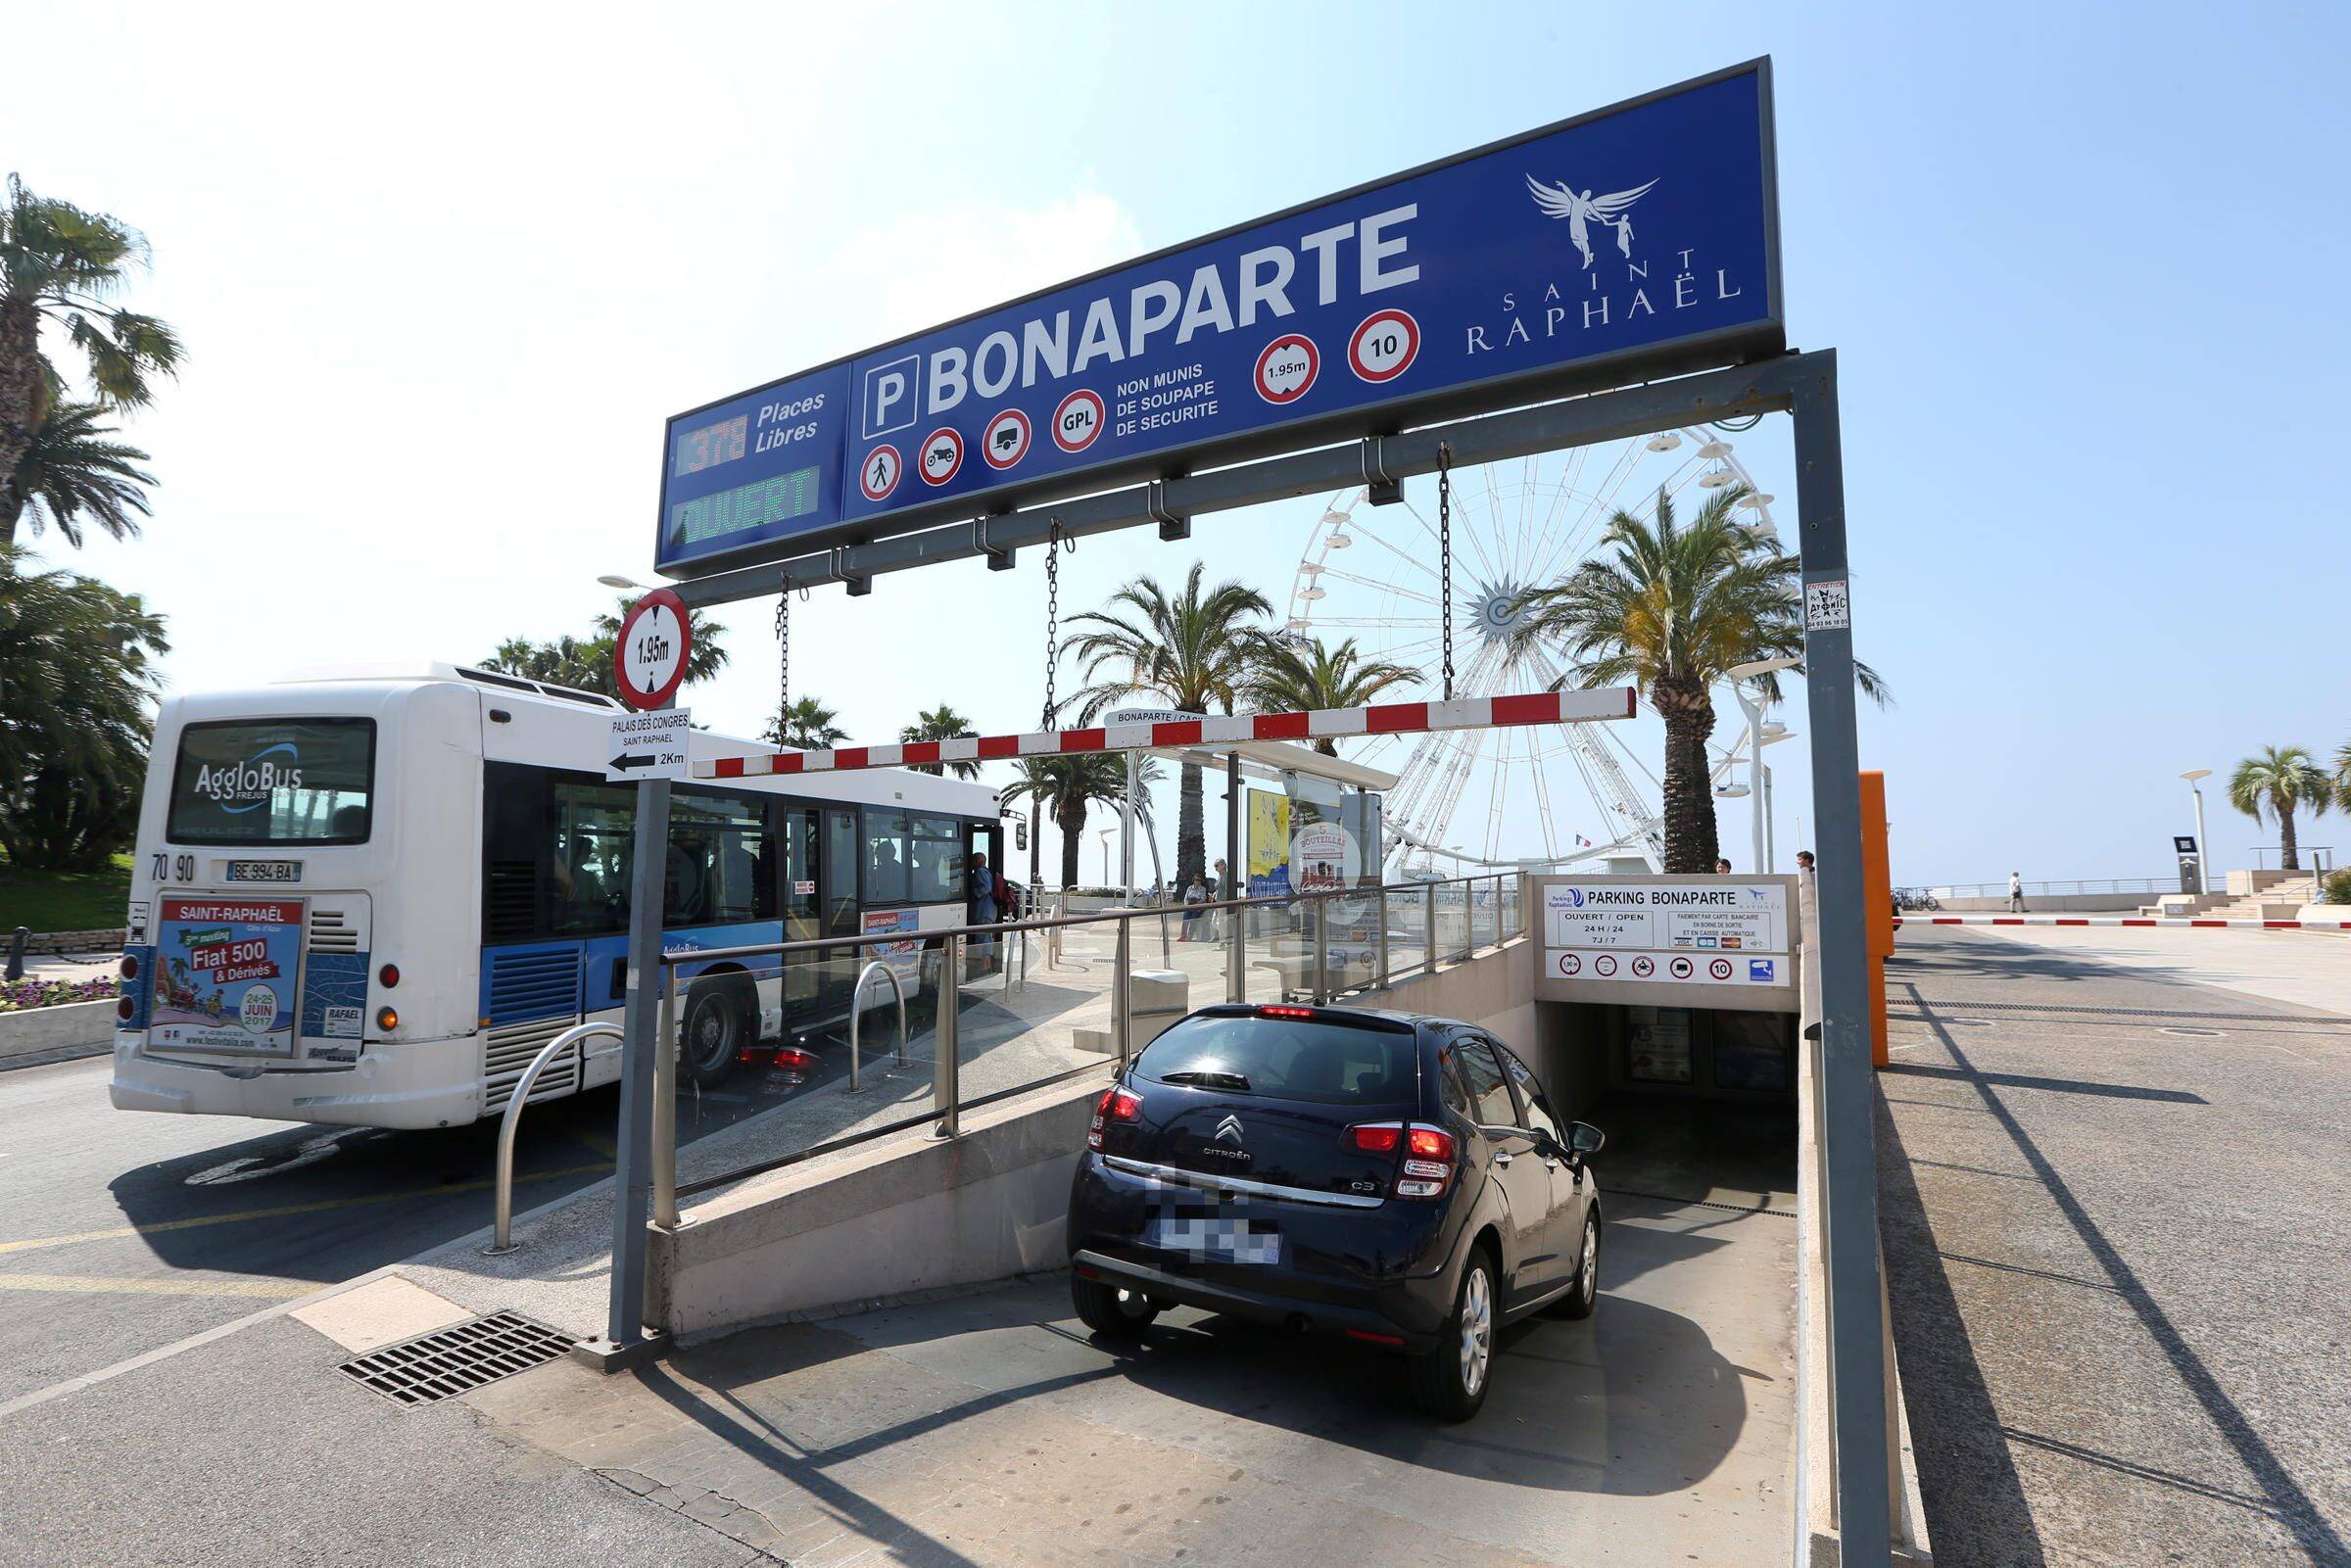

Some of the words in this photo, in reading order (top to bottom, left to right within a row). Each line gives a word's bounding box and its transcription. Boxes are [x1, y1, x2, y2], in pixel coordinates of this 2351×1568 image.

[1502, 248, 1695, 311] SAINT
[876, 370, 906, 427] P
[927, 202, 1420, 416] BONAPARTE
[1466, 268, 1742, 356] RAPHAËL
[1369, 334, 1399, 357] 10
[1267, 358, 1307, 379] 1.95m
[1117, 377, 1149, 398] NON
[1154, 363, 1203, 388] MUNIS
[1117, 400, 1137, 417] DE
[1140, 380, 1215, 411] SOUPAPE
[756, 392, 826, 429] Places
[1063, 409, 1093, 432] GPL
[1117, 419, 1136, 437] DE
[1140, 400, 1219, 431] SECURITE
[689, 415, 748, 472] 378
[754, 421, 818, 453] Libres
[682, 468, 811, 545] OUVERT
[637, 635, 669, 664] 1.95m
[612, 719, 637, 734] PALAIS
[637, 717, 652, 731] DES
[652, 714, 689, 730] CONGRES
[1118, 712, 1173, 722] BONAPARTE
[623, 736, 643, 746] SAINT
[643, 734, 674, 744] RAPHAEL
[659, 753, 684, 765] 2Km
[194, 760, 303, 800] AggloBus
[236, 790, 267, 800] FREJUS
[152, 853, 168, 881] 70
[176, 854, 195, 881] 90
[1588, 891, 1645, 905] PARKING
[1652, 891, 1737, 906] BONAPARTE
[179, 905, 285, 923] SAINT-RAPHAËL
[192, 947, 227, 970] Fiat
[231, 941, 265, 963] 500
[216, 970, 225, 982] &
[227, 964, 271, 979] Dérivés
[1714, 964, 1728, 974] 10
[245, 1004, 272, 1017] JUIN
[245, 1016, 271, 1026] 2017
[328, 1009, 360, 1020] RAFAEL
[1203, 1147, 1251, 1161] CITROËN
[1351, 1181, 1375, 1192] C3
